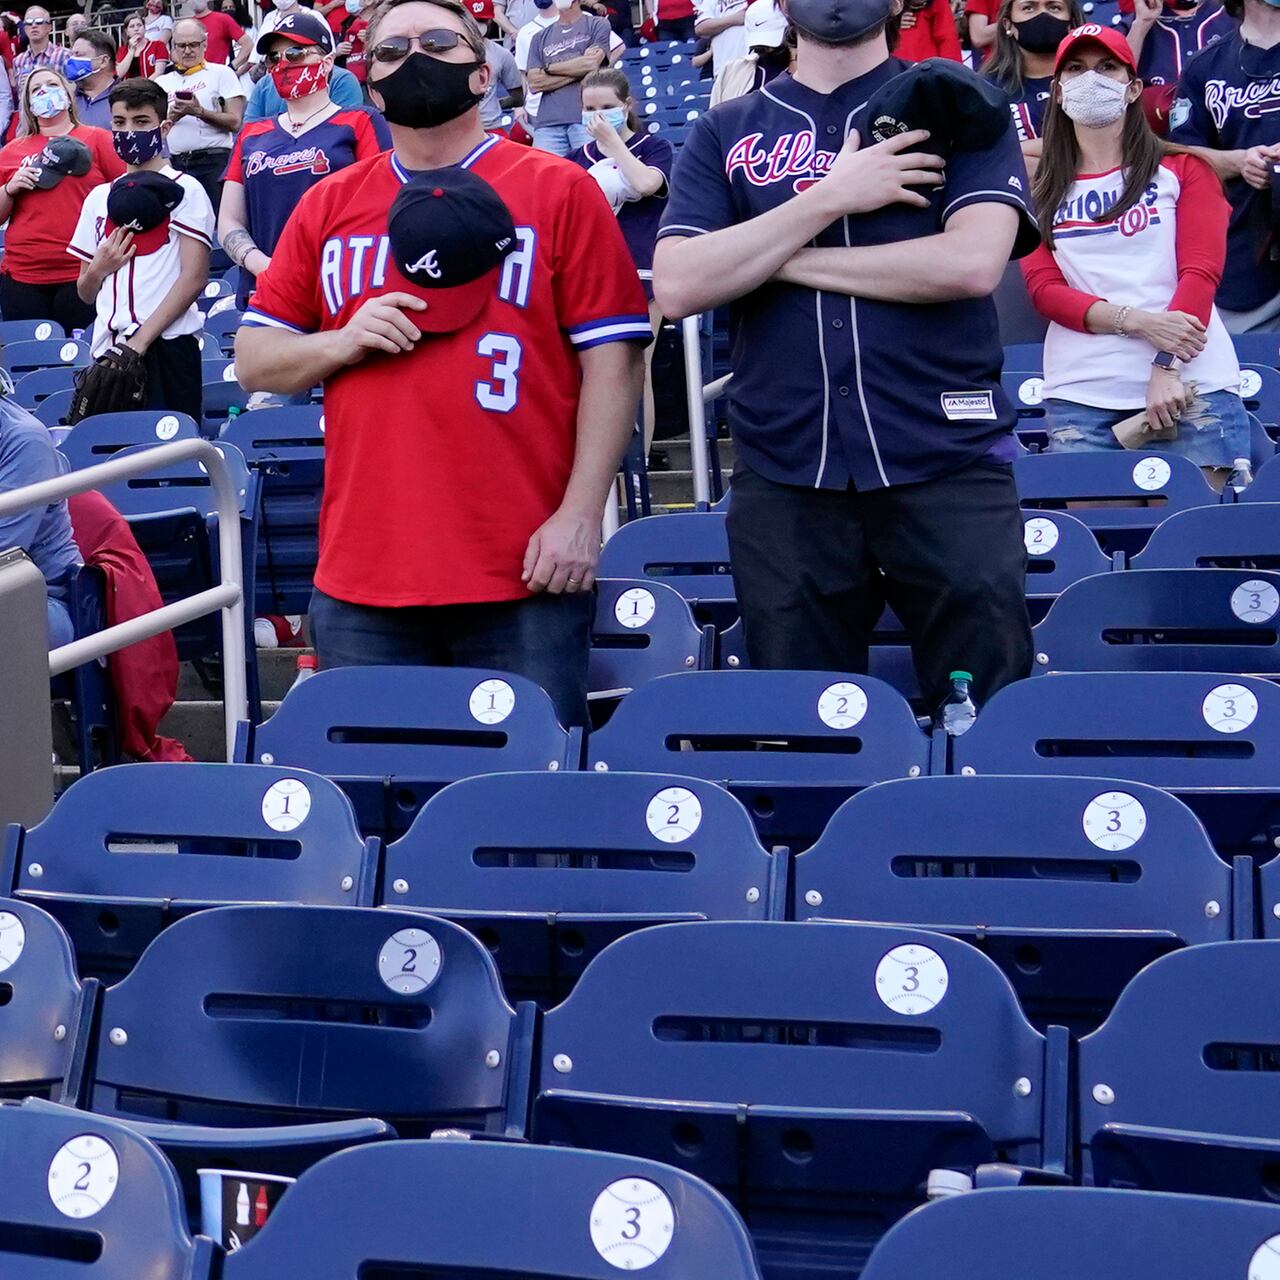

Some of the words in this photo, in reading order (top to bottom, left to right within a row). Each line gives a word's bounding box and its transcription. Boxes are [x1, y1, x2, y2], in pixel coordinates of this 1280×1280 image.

[245, 147, 317, 178] Braves
[724, 132, 836, 186] Atla
[405, 249, 441, 278] A
[475, 331, 523, 414] 3
[1031, 386, 1037, 397] 1
[957, 398, 988, 409] Majestic
[162, 422, 173, 433] 17
[1147, 467, 1156, 480] 2
[1033, 530, 1043, 543] 2
[632, 601, 640, 615] 1
[1249, 593, 1261, 609] 3
[487, 693, 496, 710] 1
[836, 697, 848, 714] 2
[1223, 700, 1236, 717] 3
[281, 796, 291, 814] 1
[666, 805, 680, 824] 2
[1106, 810, 1121, 831] 3
[401, 949, 417, 972] 2
[902, 967, 919, 991] 3
[74, 1162, 91, 1190] 2
[622, 1207, 641, 1239] 3
